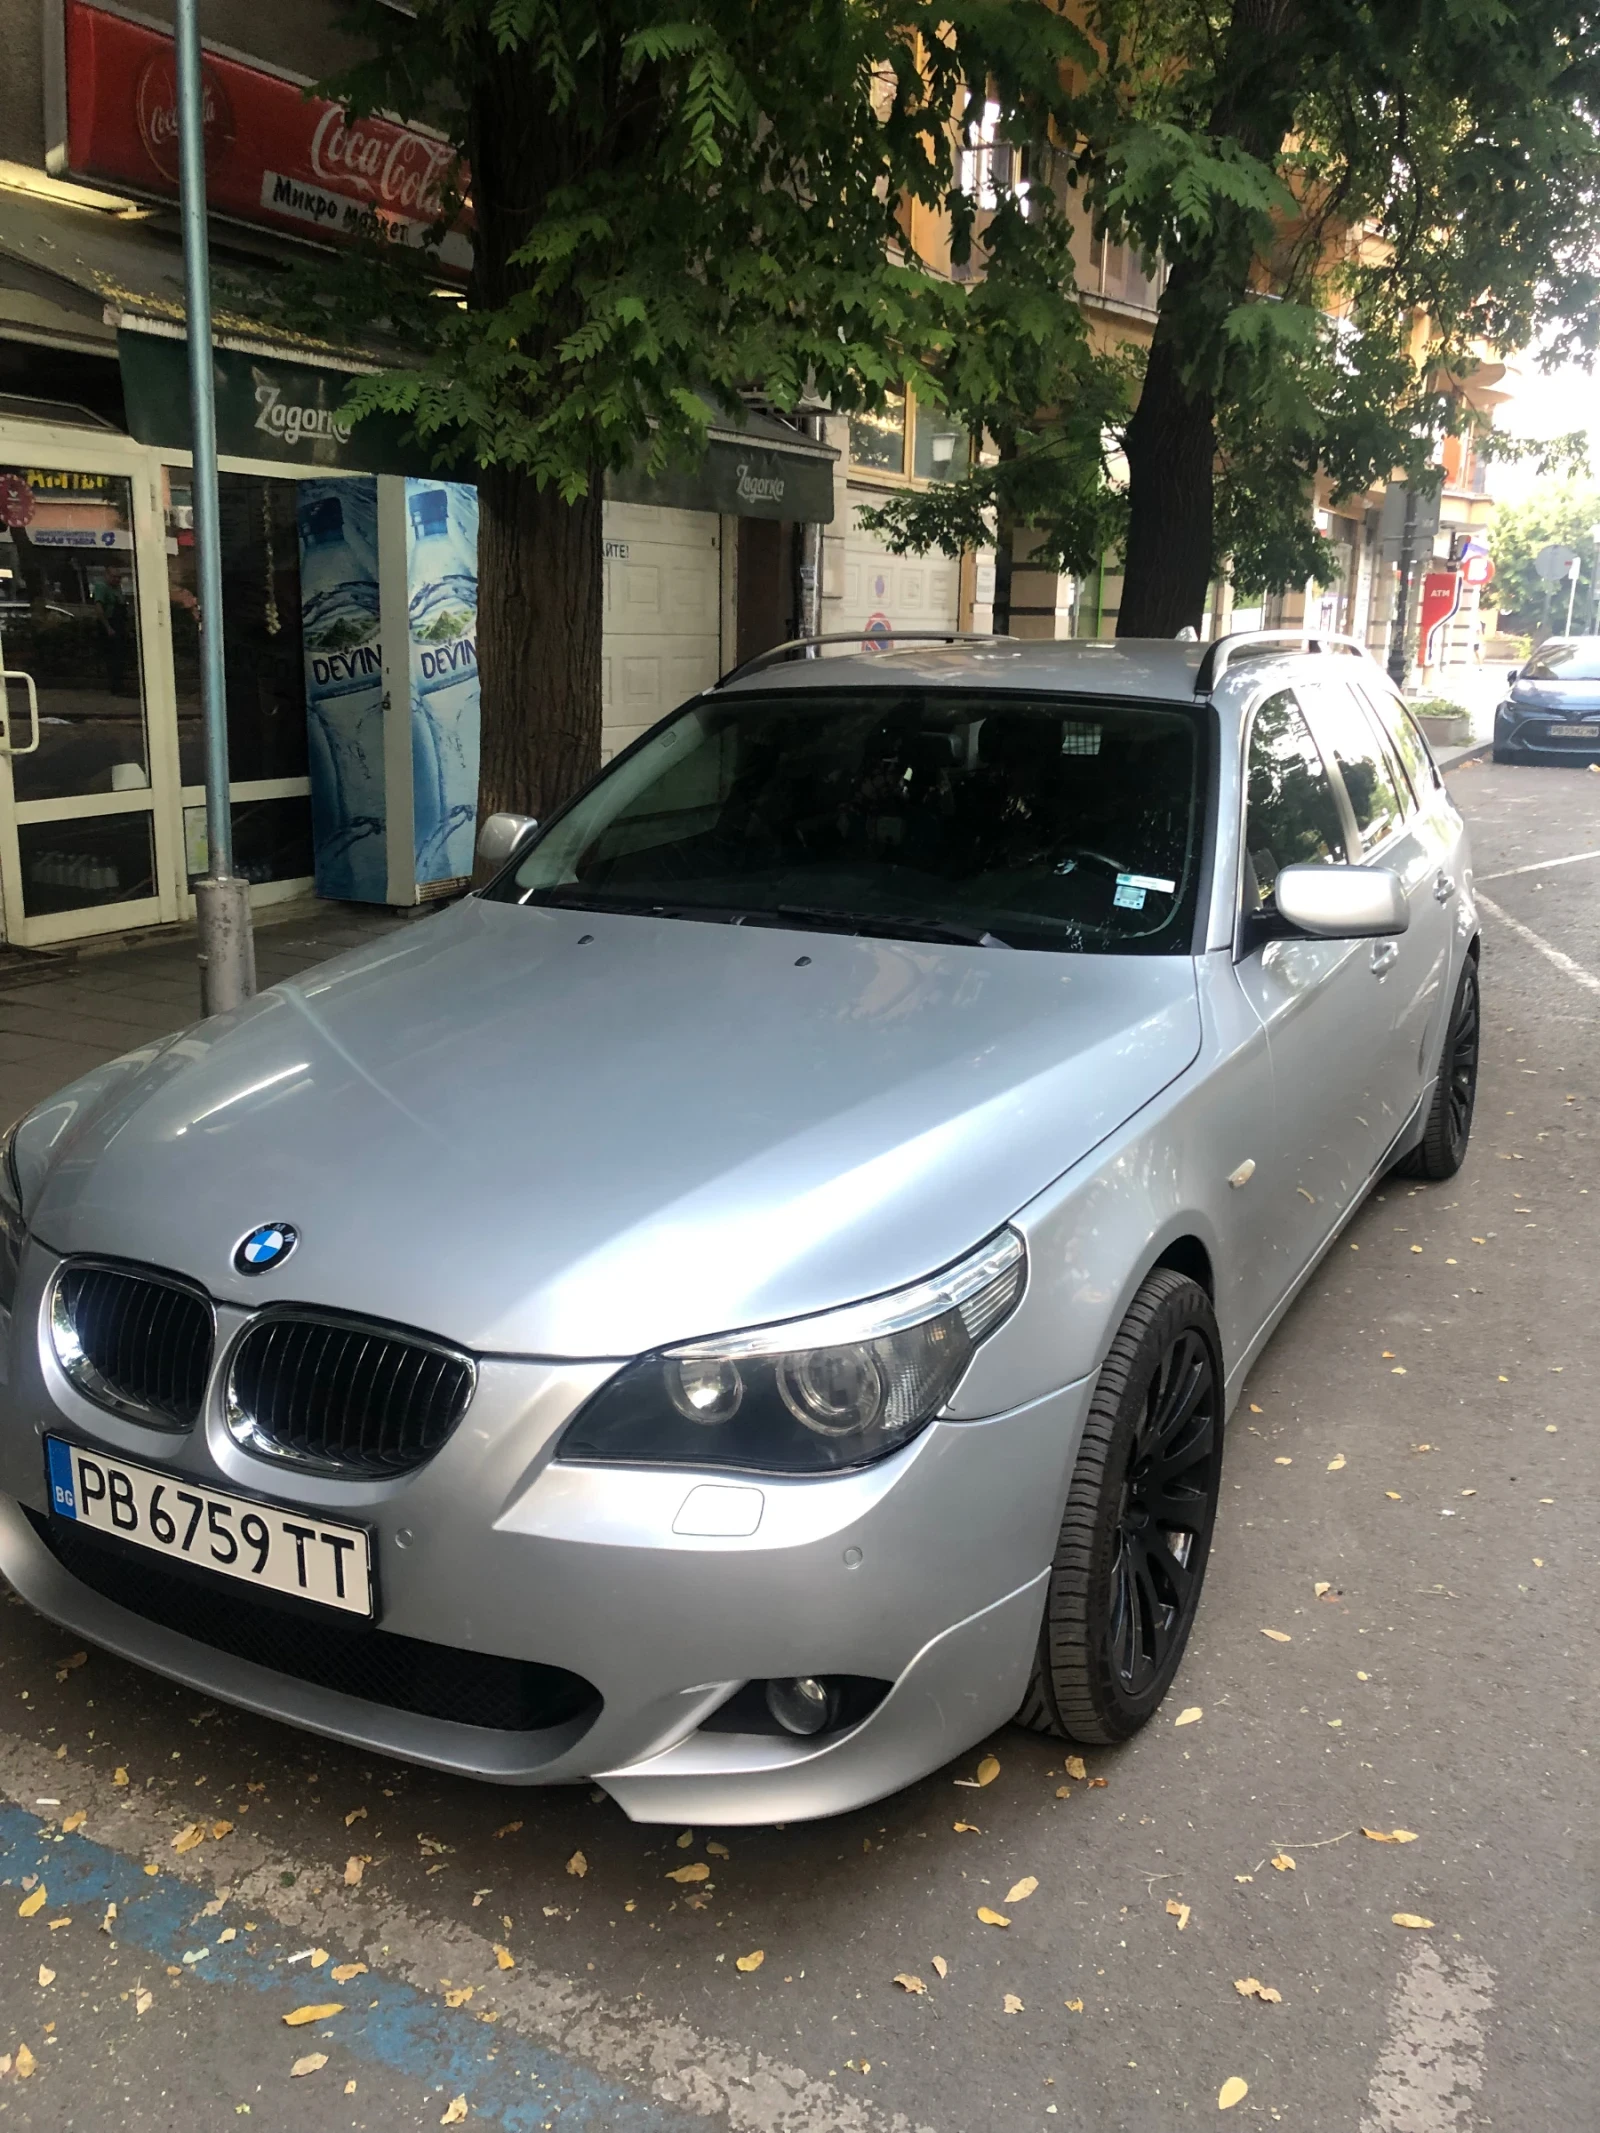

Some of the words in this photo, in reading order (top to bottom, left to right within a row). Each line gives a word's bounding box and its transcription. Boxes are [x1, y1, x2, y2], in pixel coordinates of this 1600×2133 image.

[273, 176, 338, 221] Микро
[736, 464, 785, 503] Zagorka
[1430, 589, 1451, 597] ATM
[313, 644, 382, 685] DEVIN
[55, 1485, 74, 1507] BG
[78, 1457, 138, 1531] PB
[149, 1485, 270, 1574] 6759
[282, 1522, 355, 1599] TT
